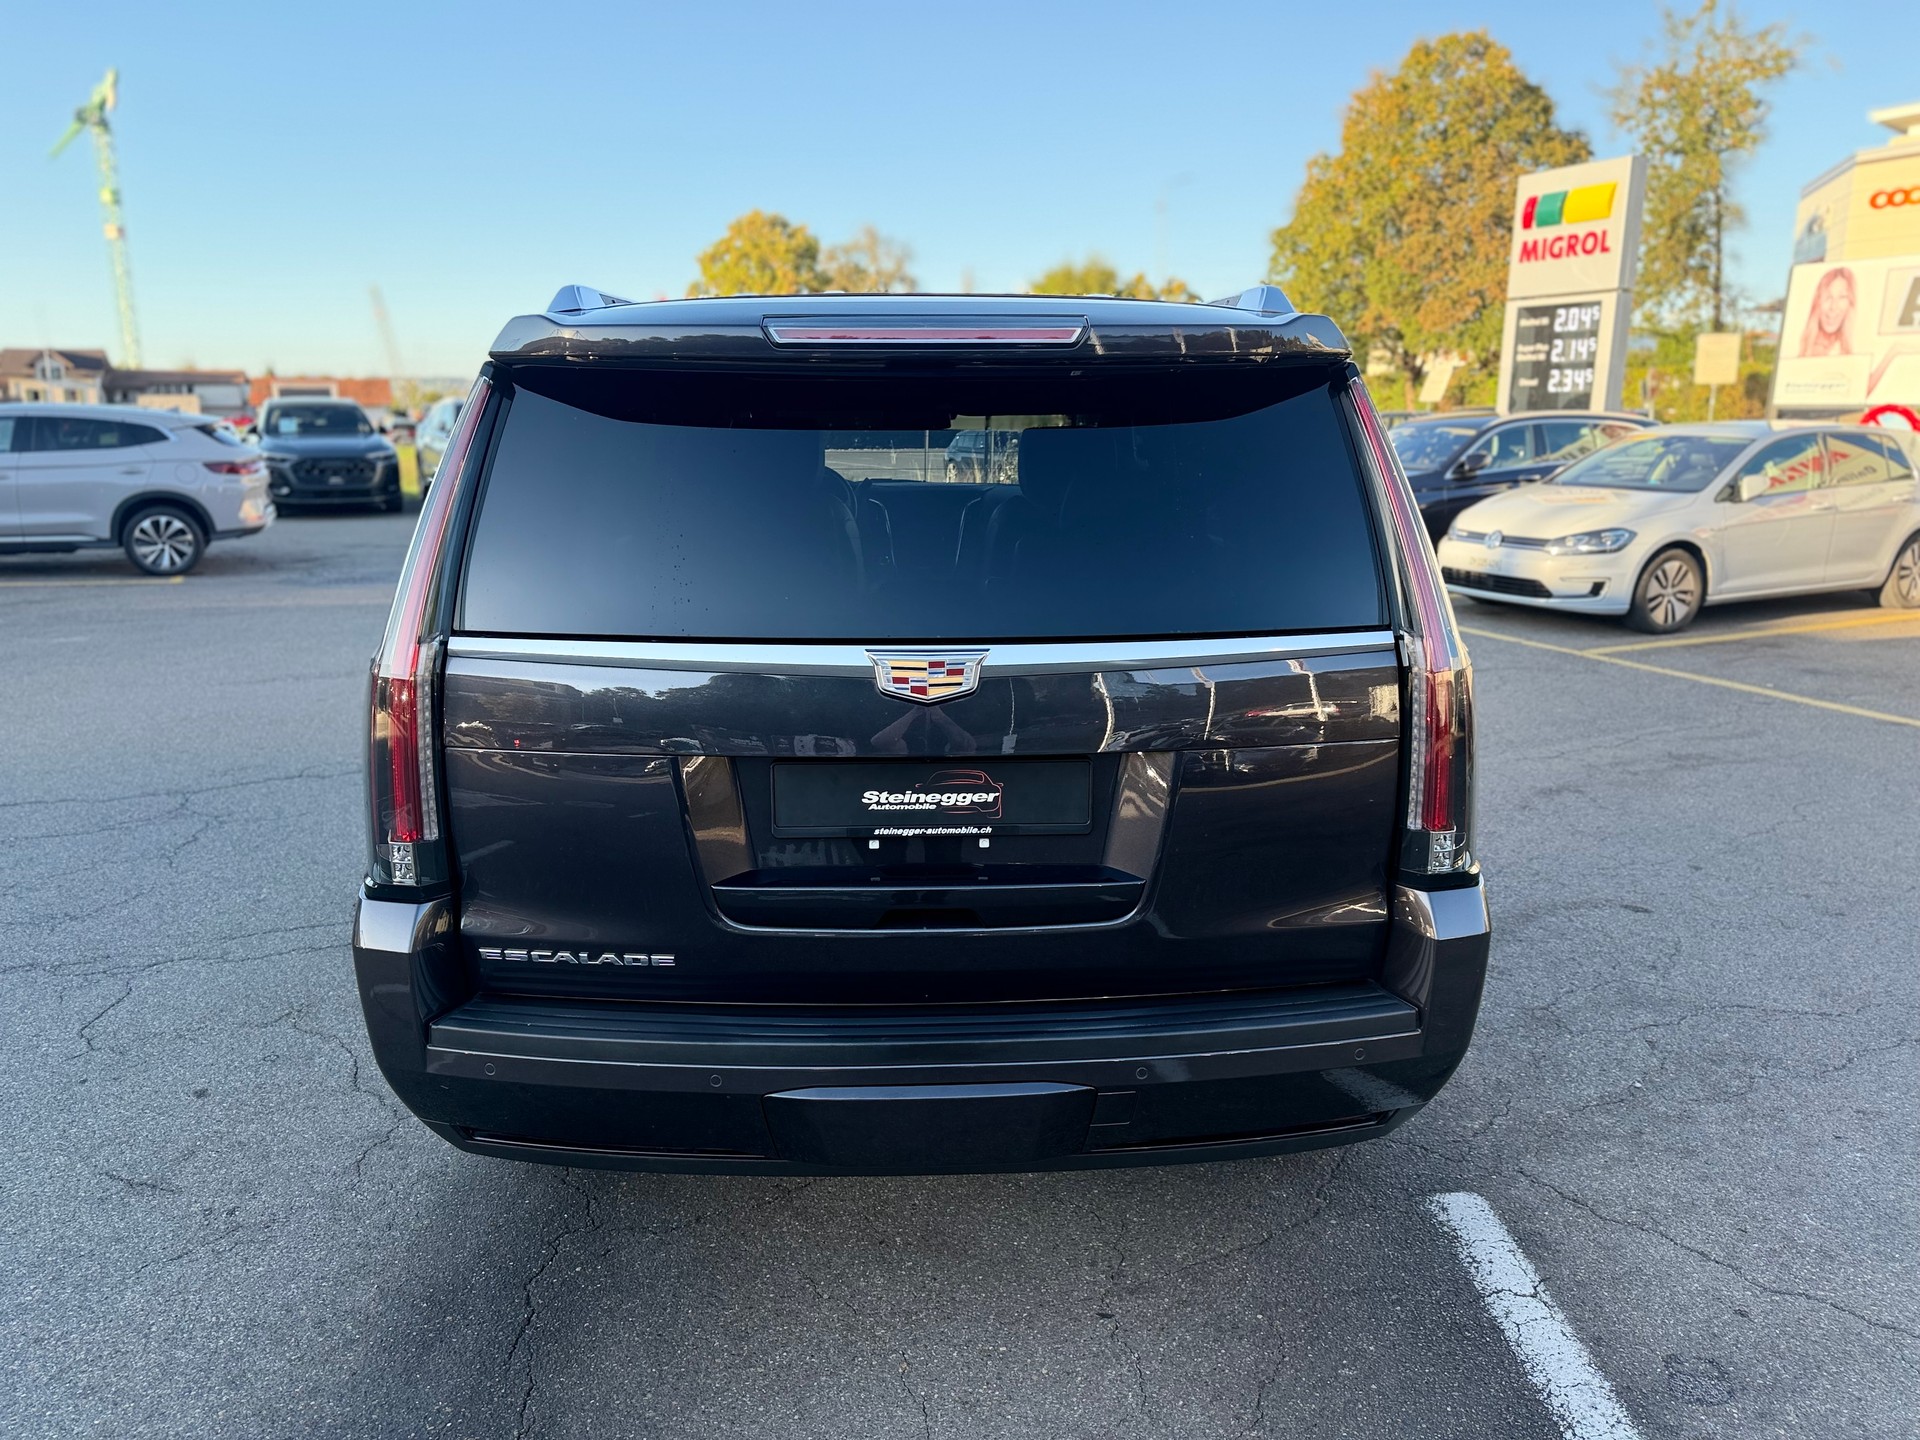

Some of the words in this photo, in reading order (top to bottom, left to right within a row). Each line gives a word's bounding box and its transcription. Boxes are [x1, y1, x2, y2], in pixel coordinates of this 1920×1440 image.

[1519, 230, 1610, 263] MIGROL
[861, 791, 1000, 806] Steinegger
[874, 827, 992, 836] steinegger-automobile.ch
[478, 947, 676, 966] ESCALADE
